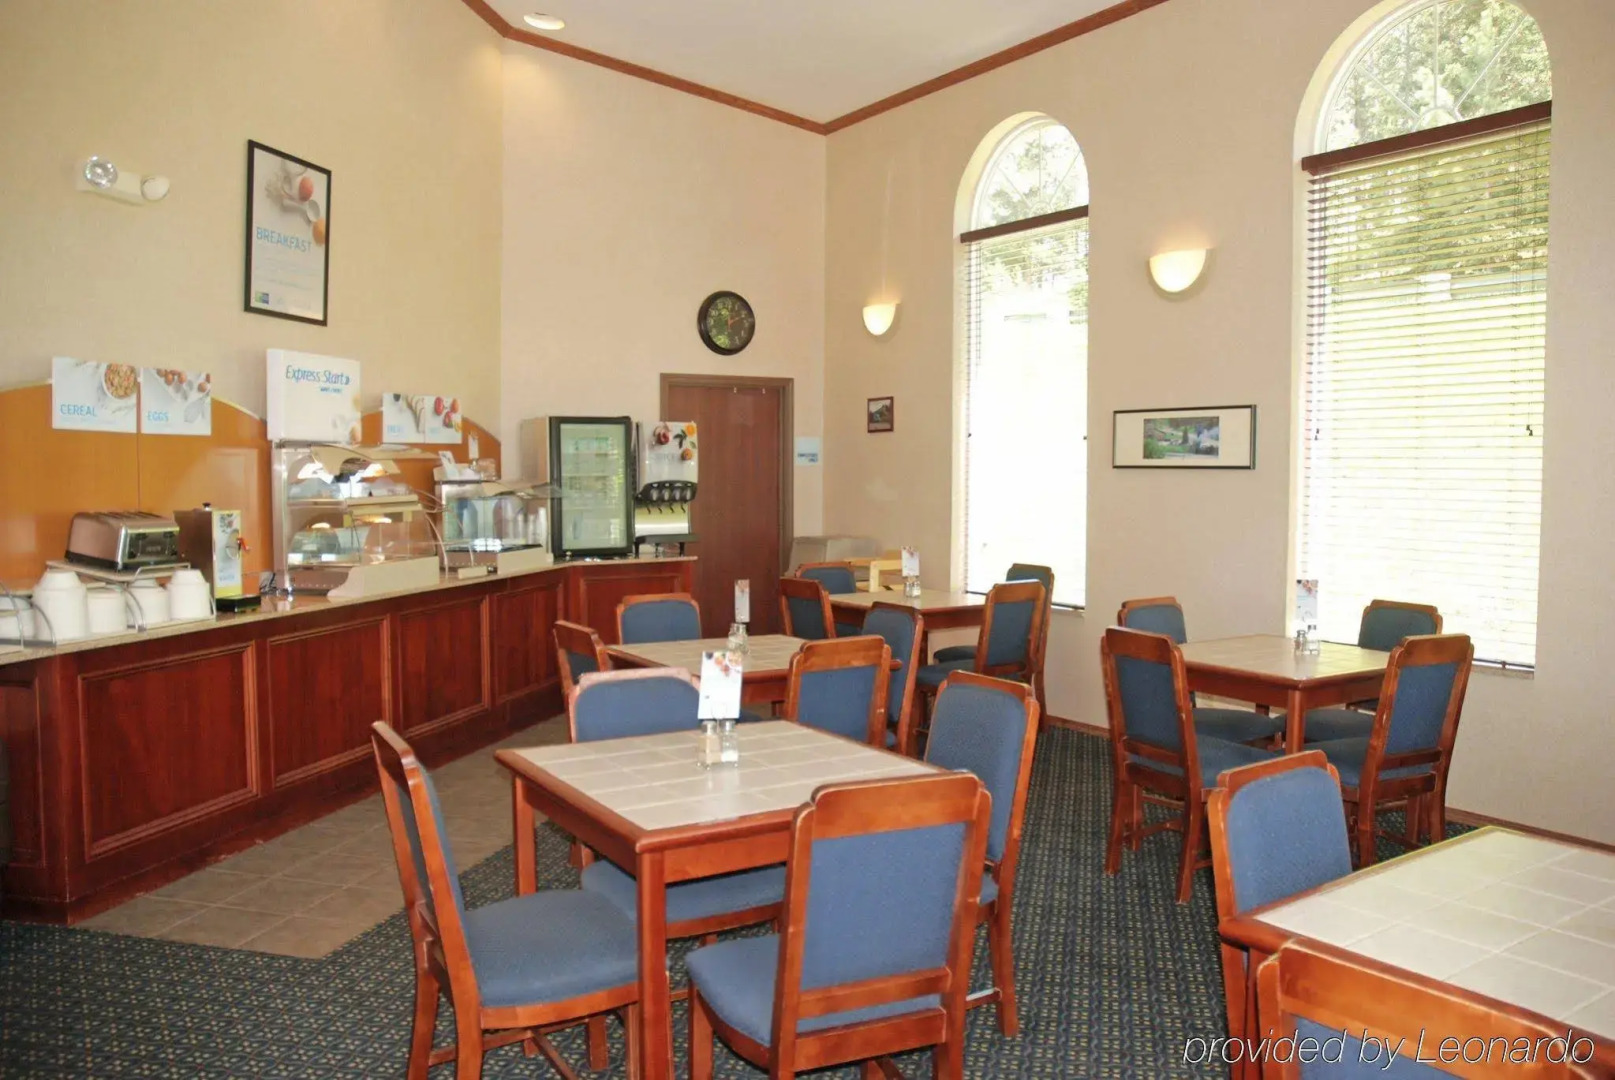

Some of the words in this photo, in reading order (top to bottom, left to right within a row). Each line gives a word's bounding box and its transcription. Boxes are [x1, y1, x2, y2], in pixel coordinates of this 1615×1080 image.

[256, 227, 312, 252] BREAKFAST
[285, 365, 321, 383] Express
[323, 369, 344, 385] Start
[60, 403, 97, 417] CEREAL
[147, 410, 169, 422] EGGS
